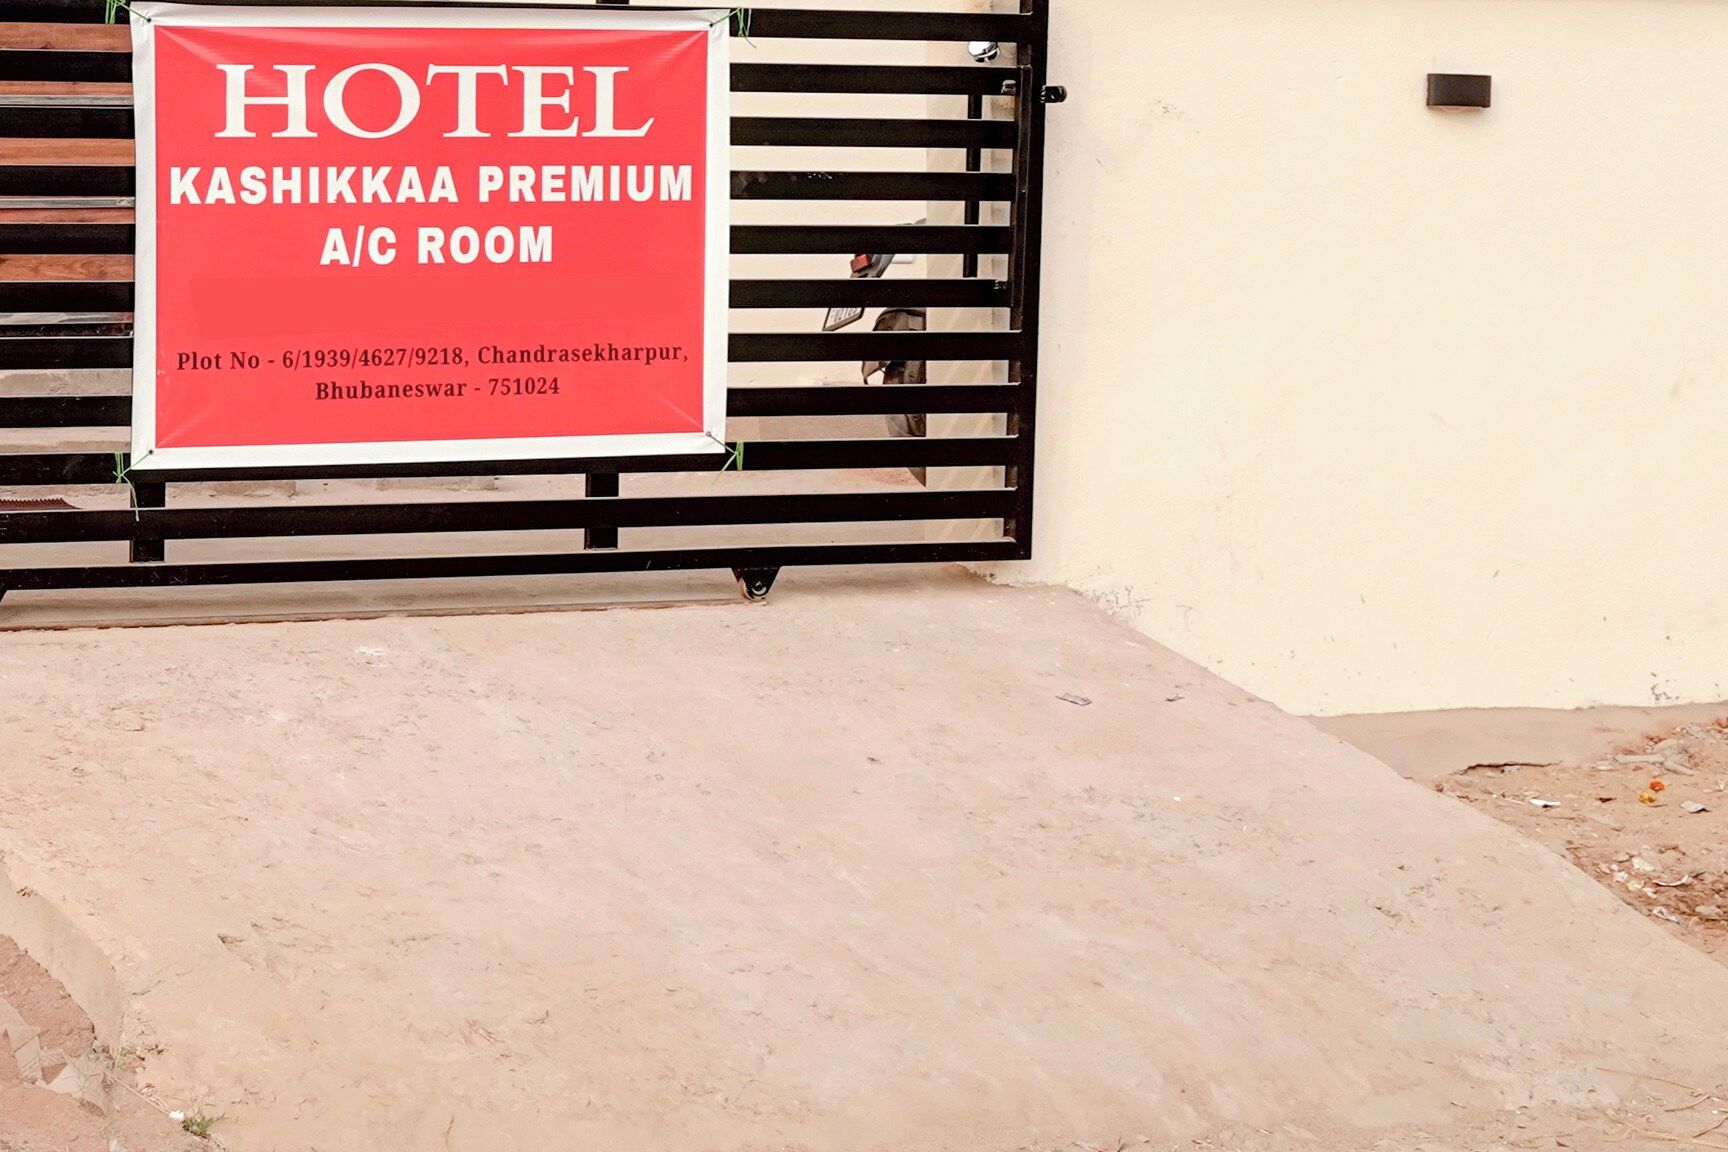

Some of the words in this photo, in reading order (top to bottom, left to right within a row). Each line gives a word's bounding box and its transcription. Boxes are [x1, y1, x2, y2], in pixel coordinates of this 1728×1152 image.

[215, 64, 654, 138] HOTEL
[171, 166, 458, 204] KASHIKKAA
[479, 166, 691, 202] PREMIUM
[320, 226, 396, 267] A/C
[418, 226, 552, 263] ROOM
[178, 352, 221, 370] Plot
[231, 352, 259, 369] No
[283, 347, 468, 370] 6/1939/4627/9218,
[478, 343, 687, 365] Chandrasekharpur,
[316, 381, 467, 400] Bhubaneswar
[489, 377, 559, 395] 751024
